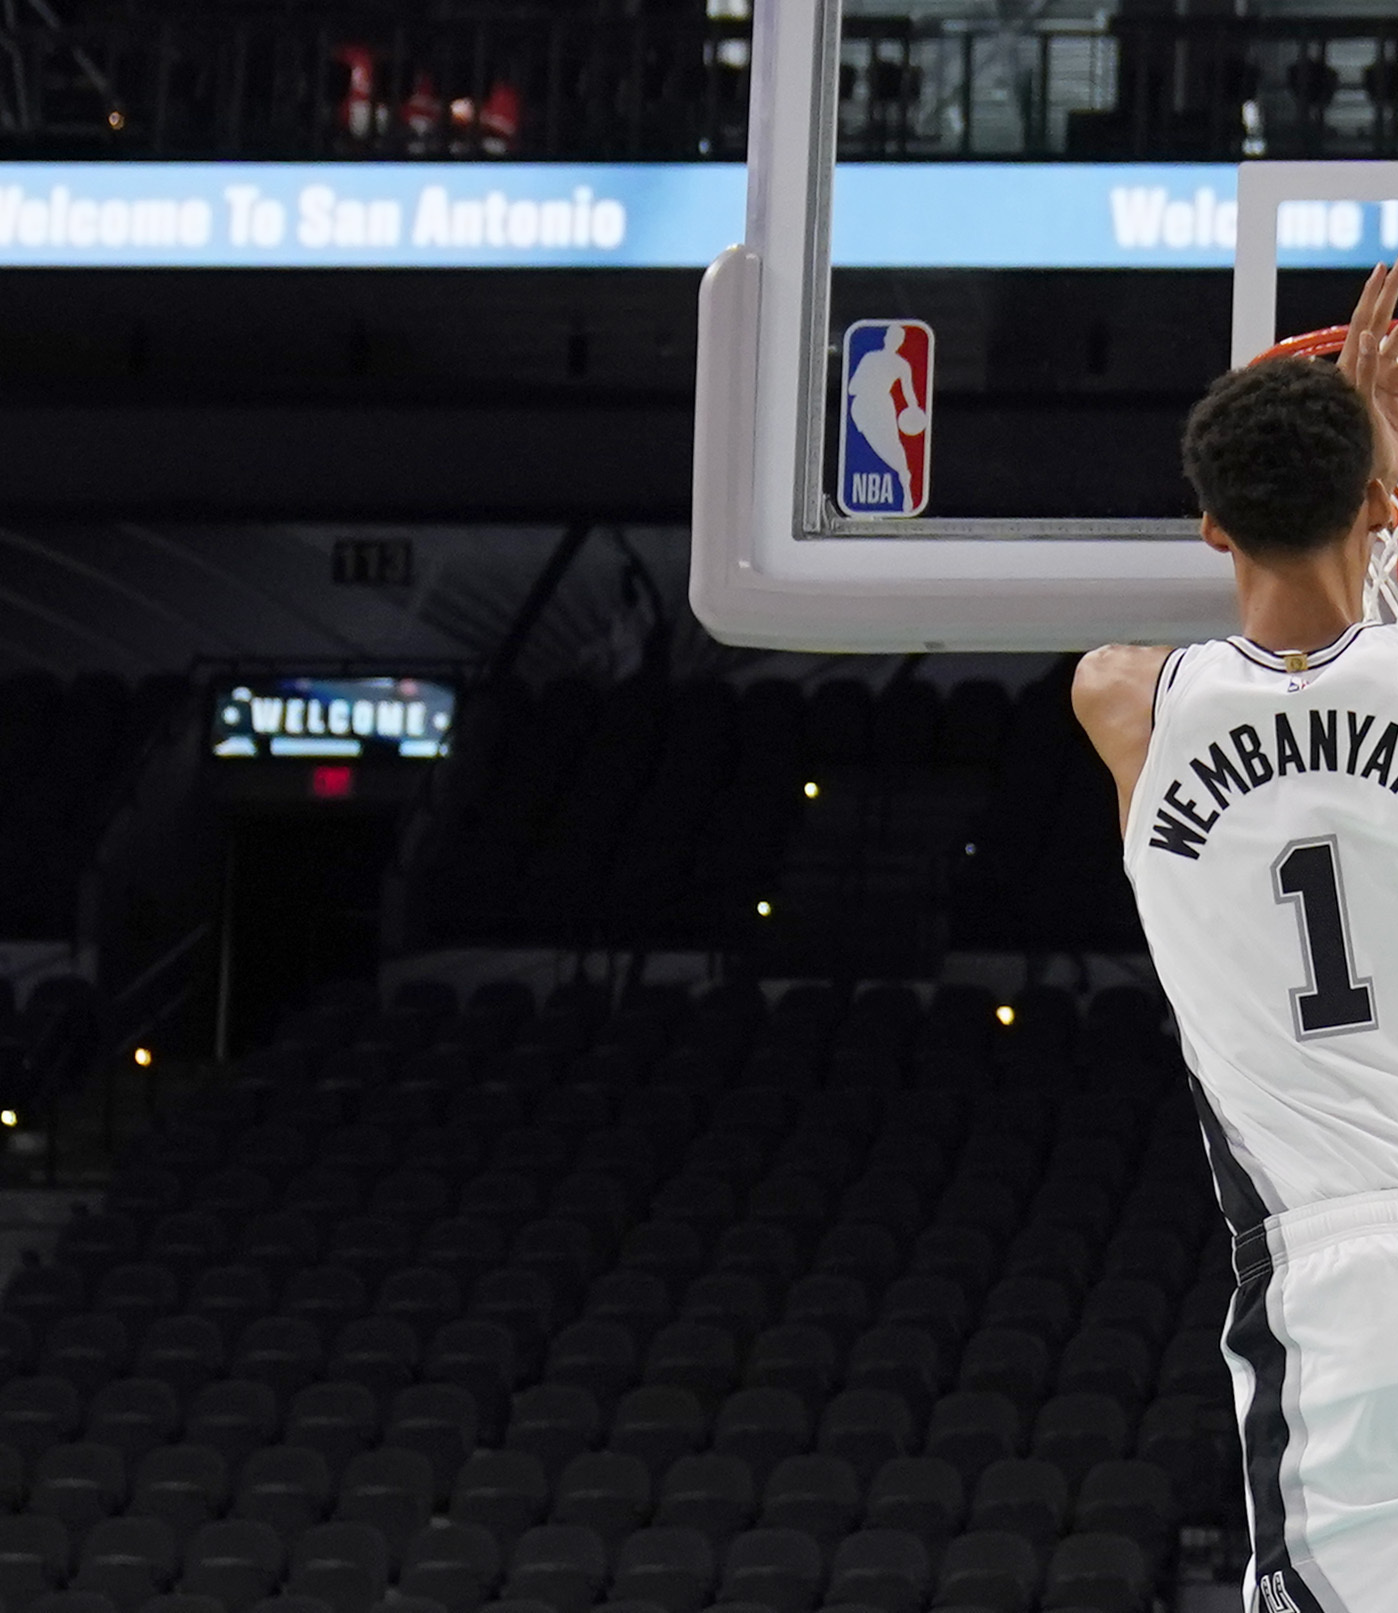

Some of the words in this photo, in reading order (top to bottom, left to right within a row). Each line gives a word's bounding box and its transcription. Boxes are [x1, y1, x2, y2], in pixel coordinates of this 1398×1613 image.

[224, 184, 286, 248] To
[298, 184, 402, 249] San
[411, 184, 627, 250] Antonio
[1110, 186, 1363, 250] Welcme
[852, 472, 894, 504] NBA
[251, 697, 425, 736] WELCOME
[1270, 834, 1379, 1041] 1
